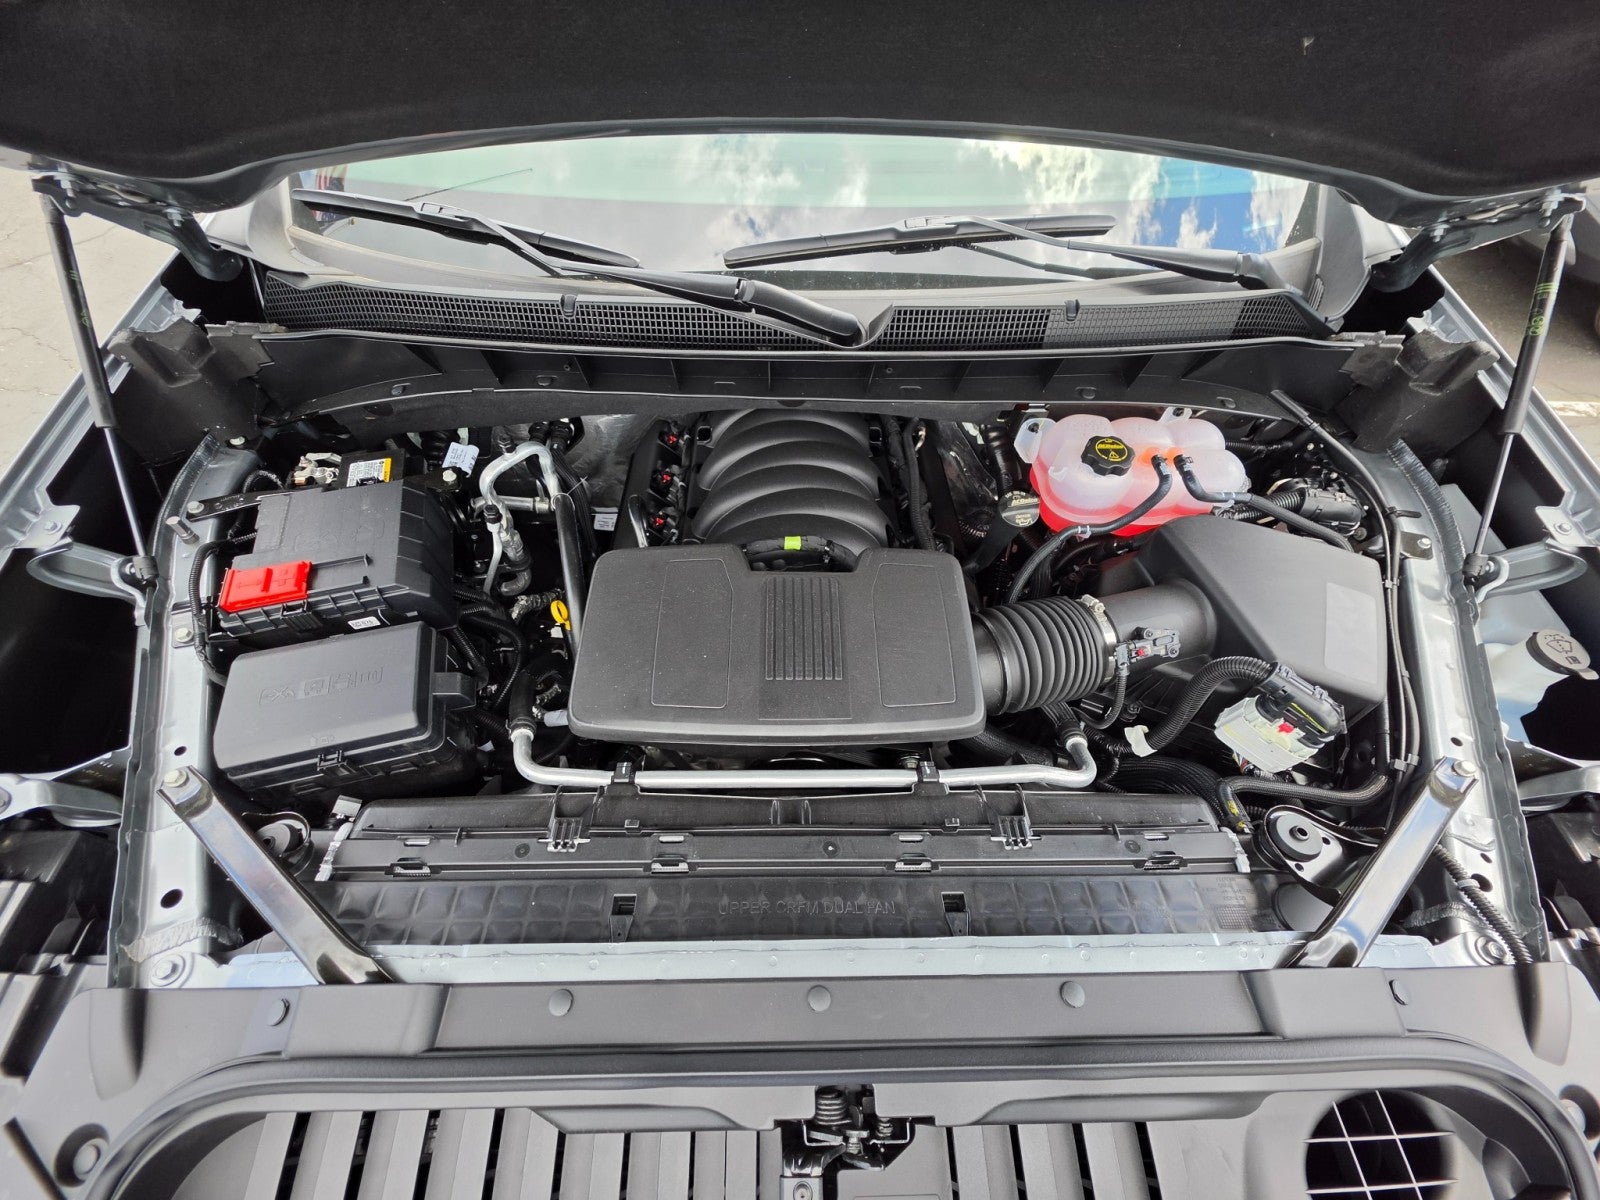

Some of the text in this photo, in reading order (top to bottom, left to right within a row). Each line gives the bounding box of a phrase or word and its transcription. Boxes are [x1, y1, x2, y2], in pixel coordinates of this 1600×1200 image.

[1011, 497, 1038, 506] ACDelco
[718, 900, 770, 915] UPPER
[776, 900, 819, 915] CRFM
[823, 900, 863, 915] DUAL
